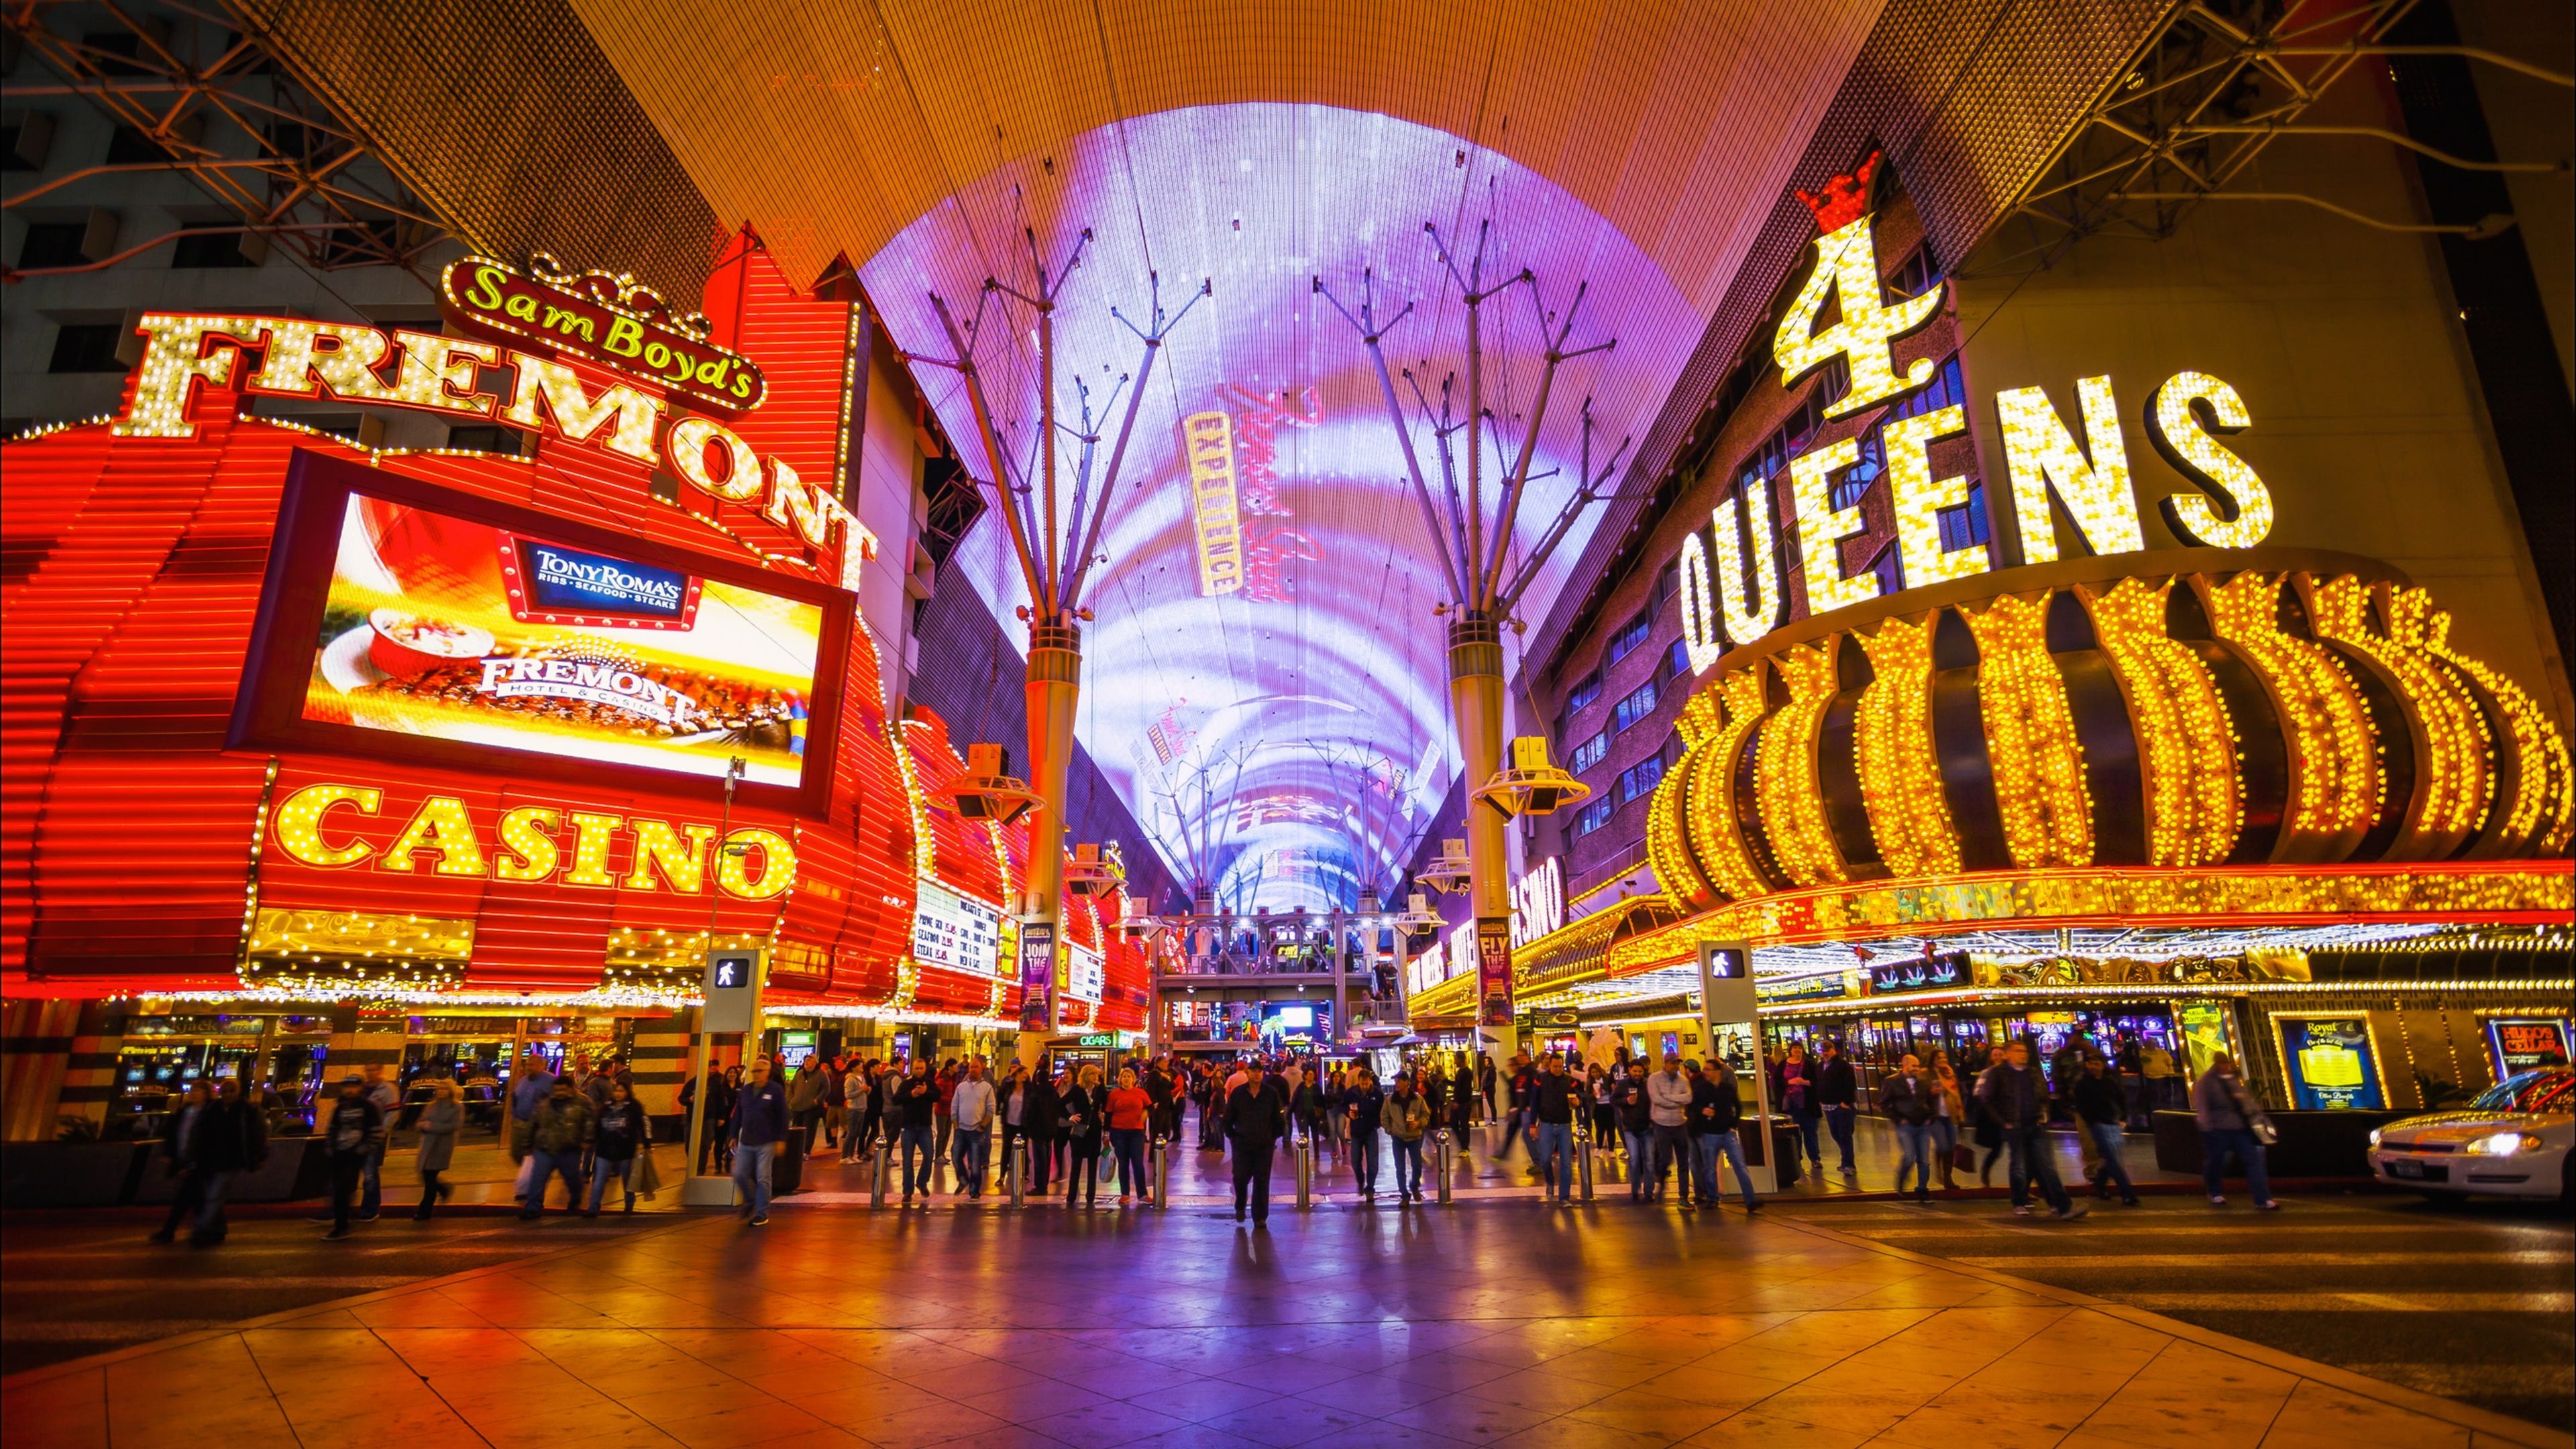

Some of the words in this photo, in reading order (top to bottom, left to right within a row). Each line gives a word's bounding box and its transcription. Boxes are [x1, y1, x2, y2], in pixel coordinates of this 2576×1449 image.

[1774, 213, 1943, 420] 4
[465, 266, 594, 343] Sam
[603, 315, 752, 398] Boyd's
[111, 312, 877, 593] FREMONT
[1194, 416, 1237, 589] EXPERIENCE
[1680, 371, 2273, 676] QUEENS
[538, 573, 567, 586] RIBS
[575, 581, 627, 599] SEAFOOD
[634, 594, 676, 610] STEAKS
[476, 657, 697, 724] FREMONT
[510, 684, 568, 695] HOTEL
[598, 692, 658, 716] CASINO
[274, 784, 797, 901] CASINO
[1025, 943, 1051, 958] JOIN
[1480, 937, 1509, 955] FLY
[1028, 958, 1046, 967] THE
[1483, 955, 1505, 965] THE
[434, 1019, 492, 1031] BUFFET
[2307, 1022, 2338, 1037] Royal
[2502, 1026, 2554, 1039] HUGO'S
[1080, 1035, 1112, 1046] CIGARS
[2505, 1039, 2556, 1053] CELLAR
